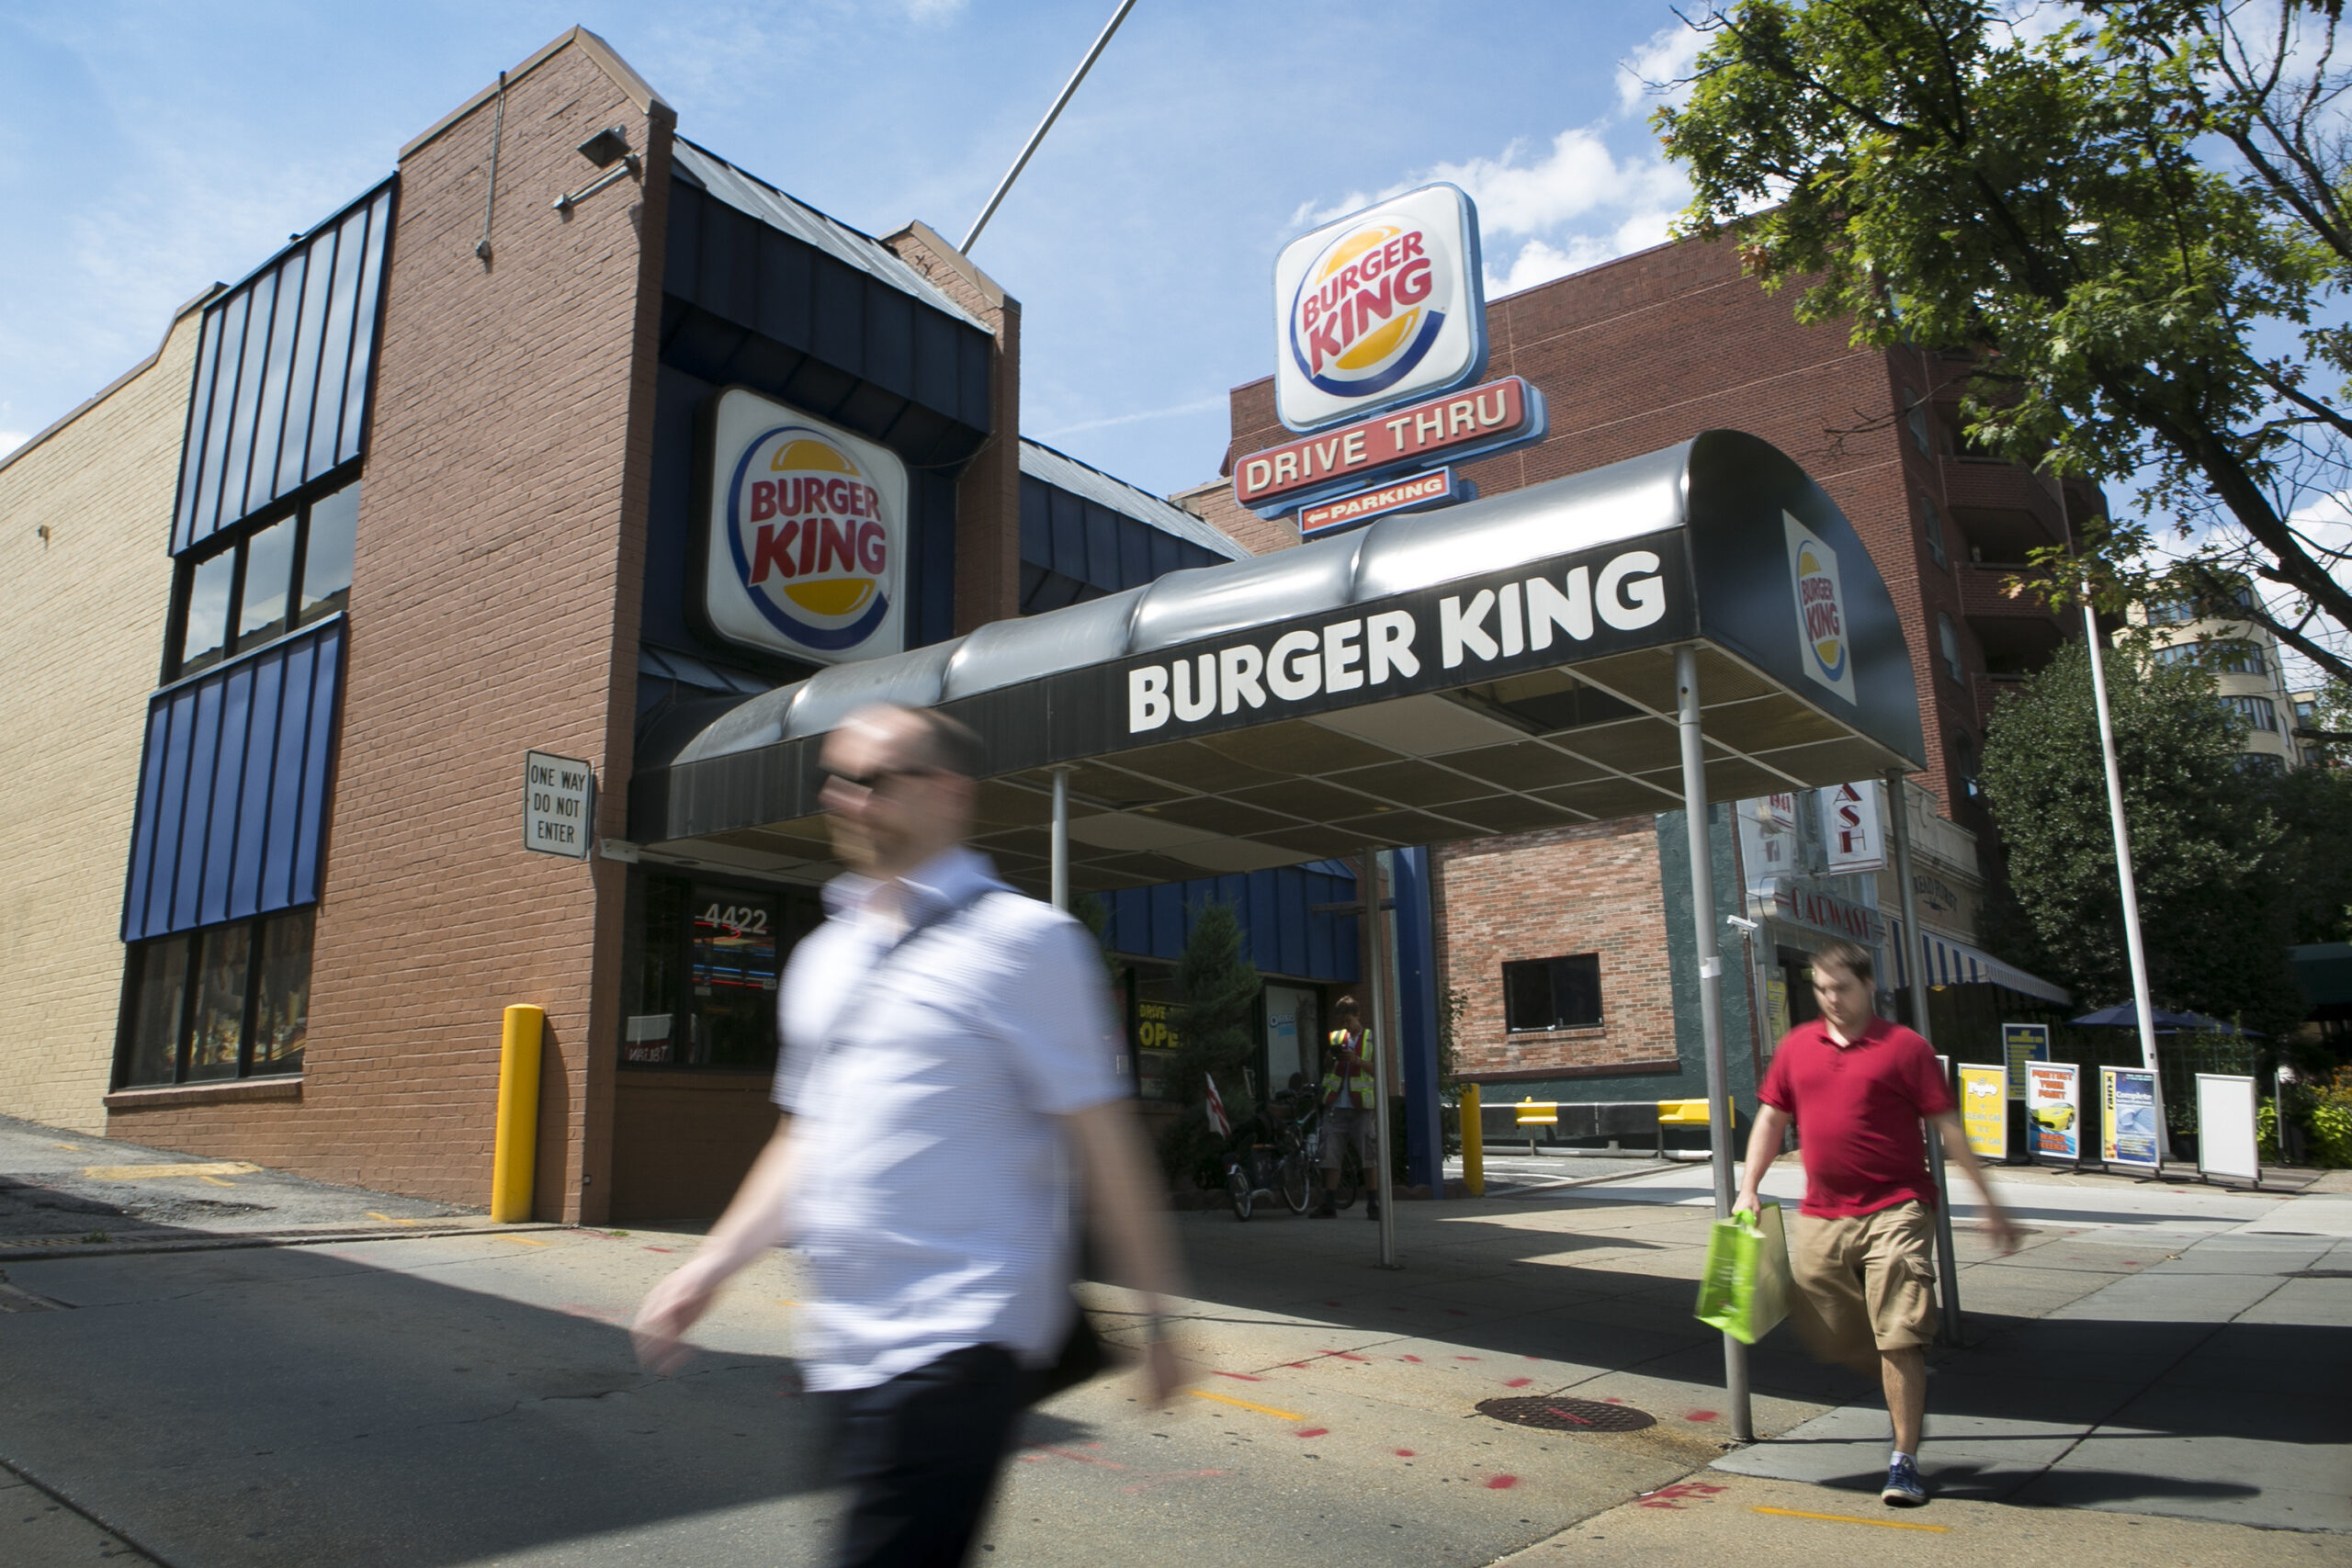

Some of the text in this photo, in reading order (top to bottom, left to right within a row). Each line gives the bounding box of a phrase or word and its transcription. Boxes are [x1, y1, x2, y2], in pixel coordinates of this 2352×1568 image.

[1303, 231, 1424, 333] BURGER
[1308, 257, 1432, 376] KING
[1246, 389, 1507, 493] DRIVE THRU
[750, 477, 882, 523] BURGER
[1330, 478, 1442, 520] PARKING
[751, 518, 886, 584] KING
[1801, 577, 1835, 605] BURGER
[1128, 550, 1667, 734] BURGER KING
[1806, 603, 1840, 643] KING
[530, 764, 586, 792] ONE WAY
[534, 793, 580, 818] DO NOT
[1833, 783, 1867, 853] ASH
[537, 820, 574, 843] ENTER
[705, 903, 767, 934] 4422
[1139, 1021, 1191, 1048] OPE
